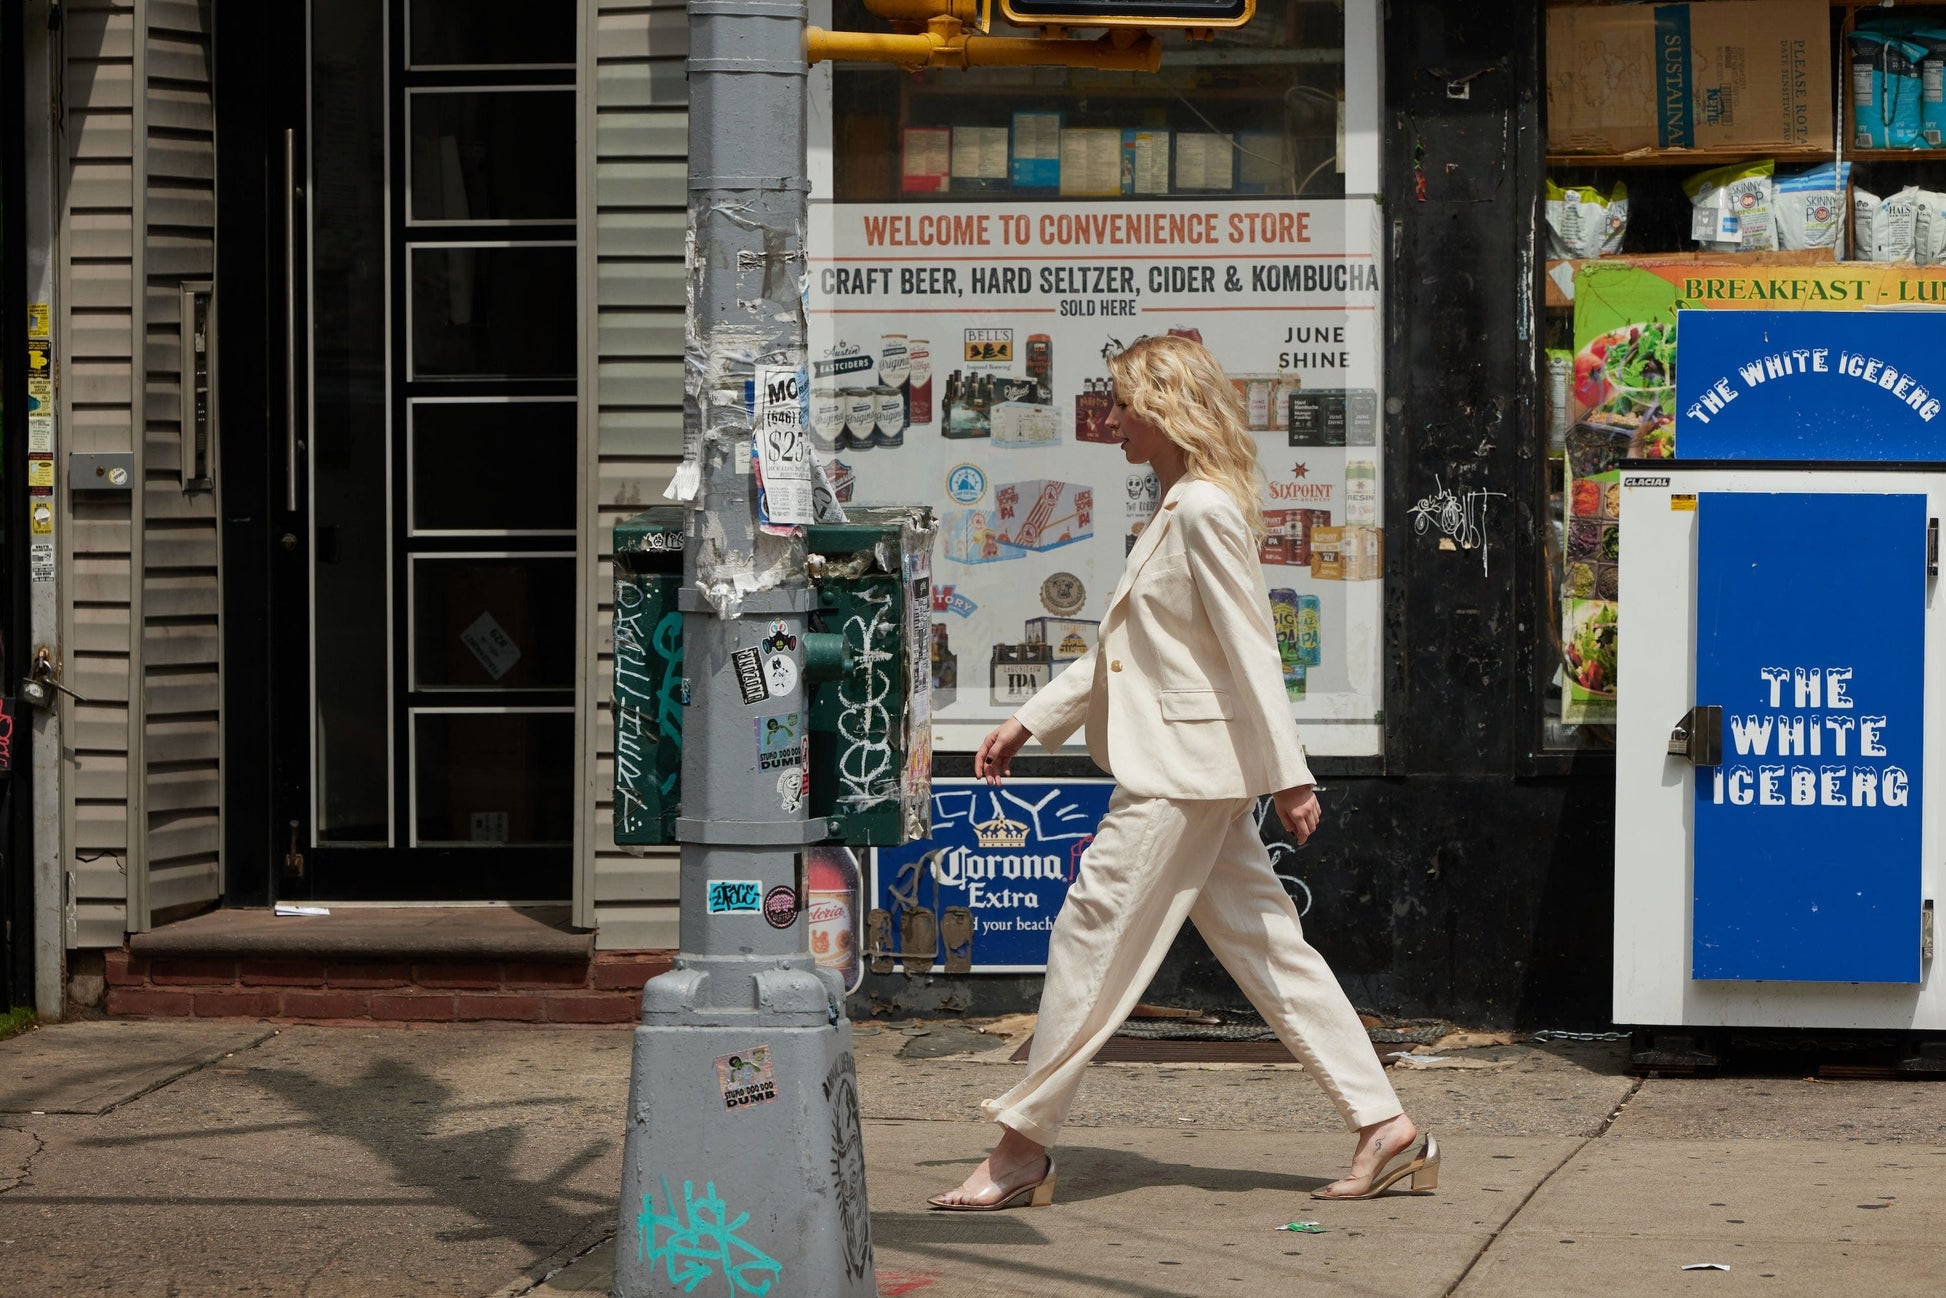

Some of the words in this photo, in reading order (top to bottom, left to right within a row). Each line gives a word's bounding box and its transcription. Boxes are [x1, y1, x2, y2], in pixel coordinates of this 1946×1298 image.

[1781, 39, 1789, 68] DATE
[1794, 39, 1808, 94] PLEASE
[1664, 34, 1687, 147] SUSTAINA
[1782, 70, 1791, 115] SENSITIVE
[1783, 117, 1793, 144] PRO
[1732, 180, 1762, 195] SKINNY
[1731, 191, 1764, 213] POP
[864, 214, 991, 247] WELCOME
[998, 213, 1031, 246] TO
[1039, 212, 1219, 246] CONVENIENCE
[1228, 211, 1311, 244] STORE
[821, 267, 893, 296] CRAFT
[901, 267, 963, 298] BEER,
[971, 266, 1032, 295] HARD
[1039, 265, 1141, 297] SELTZER,
[1148, 264, 1216, 294] CIDER
[1224, 264, 1243, 292] &
[1251, 263, 1380, 293] KOMBUCHA
[1684, 279, 1871, 301] BREAKFAST
[1899, 279, 1946, 301] LU
[1060, 299, 1096, 317] SOLD
[1100, 299, 1137, 317] HERE
[968, 330, 1010, 341] BELL'S
[1284, 326, 1344, 344] JUNE
[824, 344, 861, 358] Austin
[1279, 352, 1350, 369] SHINE
[820, 358, 869, 373] EASTCIDERS
[1686, 376, 1738, 424] THE
[1738, 348, 1829, 388] WHITE
[1838, 350, 1942, 423] ICEBERG
[767, 410, 796, 428] (646)
[1269, 480, 1333, 500] SIXPOINT
[1625, 478, 1668, 486] GLACIAL
[1001, 506, 1014, 520] IPA
[1078, 512, 1091, 528] IPA
[1008, 674, 1038, 695] IPA
[1761, 667, 1853, 709] THE
[1730, 715, 1887, 757] WHITE
[760, 750, 778, 762] STUPID
[761, 756, 802, 770] DUMB
[1713, 765, 1909, 807] ICEBERG
[930, 845, 1064, 891] Corona
[968, 882, 1040, 909] Extra
[808, 905, 845, 920] ctoria
[983, 918, 1013, 936] your
[724, 1088, 745, 1100] STUPID
[746, 1083, 760, 1095] DOO
[760, 1081, 774, 1091] DOO
[726, 1090, 776, 1108] DUMB
